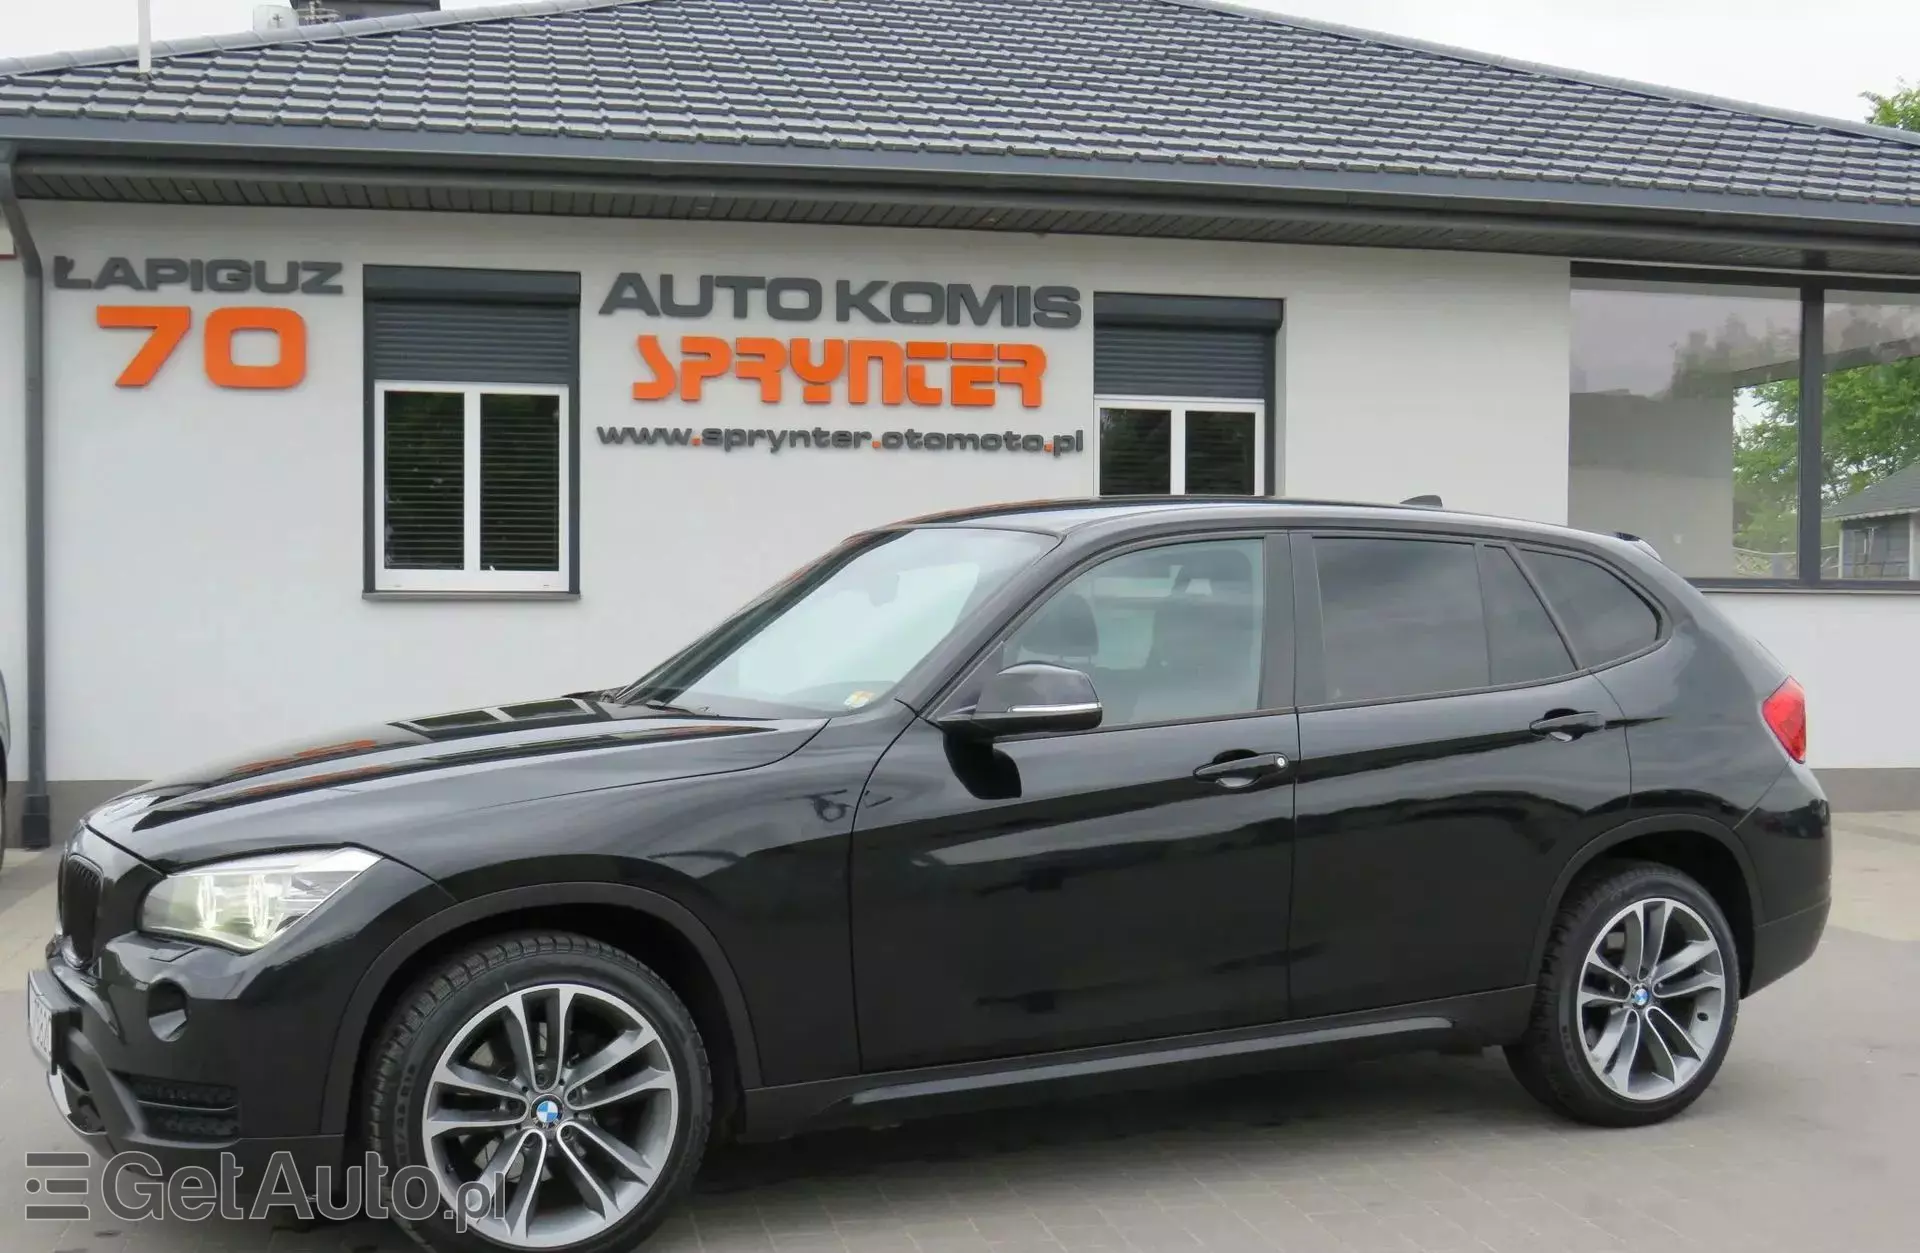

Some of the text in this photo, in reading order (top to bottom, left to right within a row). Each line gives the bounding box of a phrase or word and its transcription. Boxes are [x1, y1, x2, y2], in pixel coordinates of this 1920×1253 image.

[54, 256, 344, 294] ŁAPIGUZ
[599, 272, 1082, 328] AUTO KOMIS
[96, 305, 307, 389] 70
[632, 335, 1047, 408] SPRYNTER
[597, 426, 1084, 457] www.sprynter.otomoto.pl
